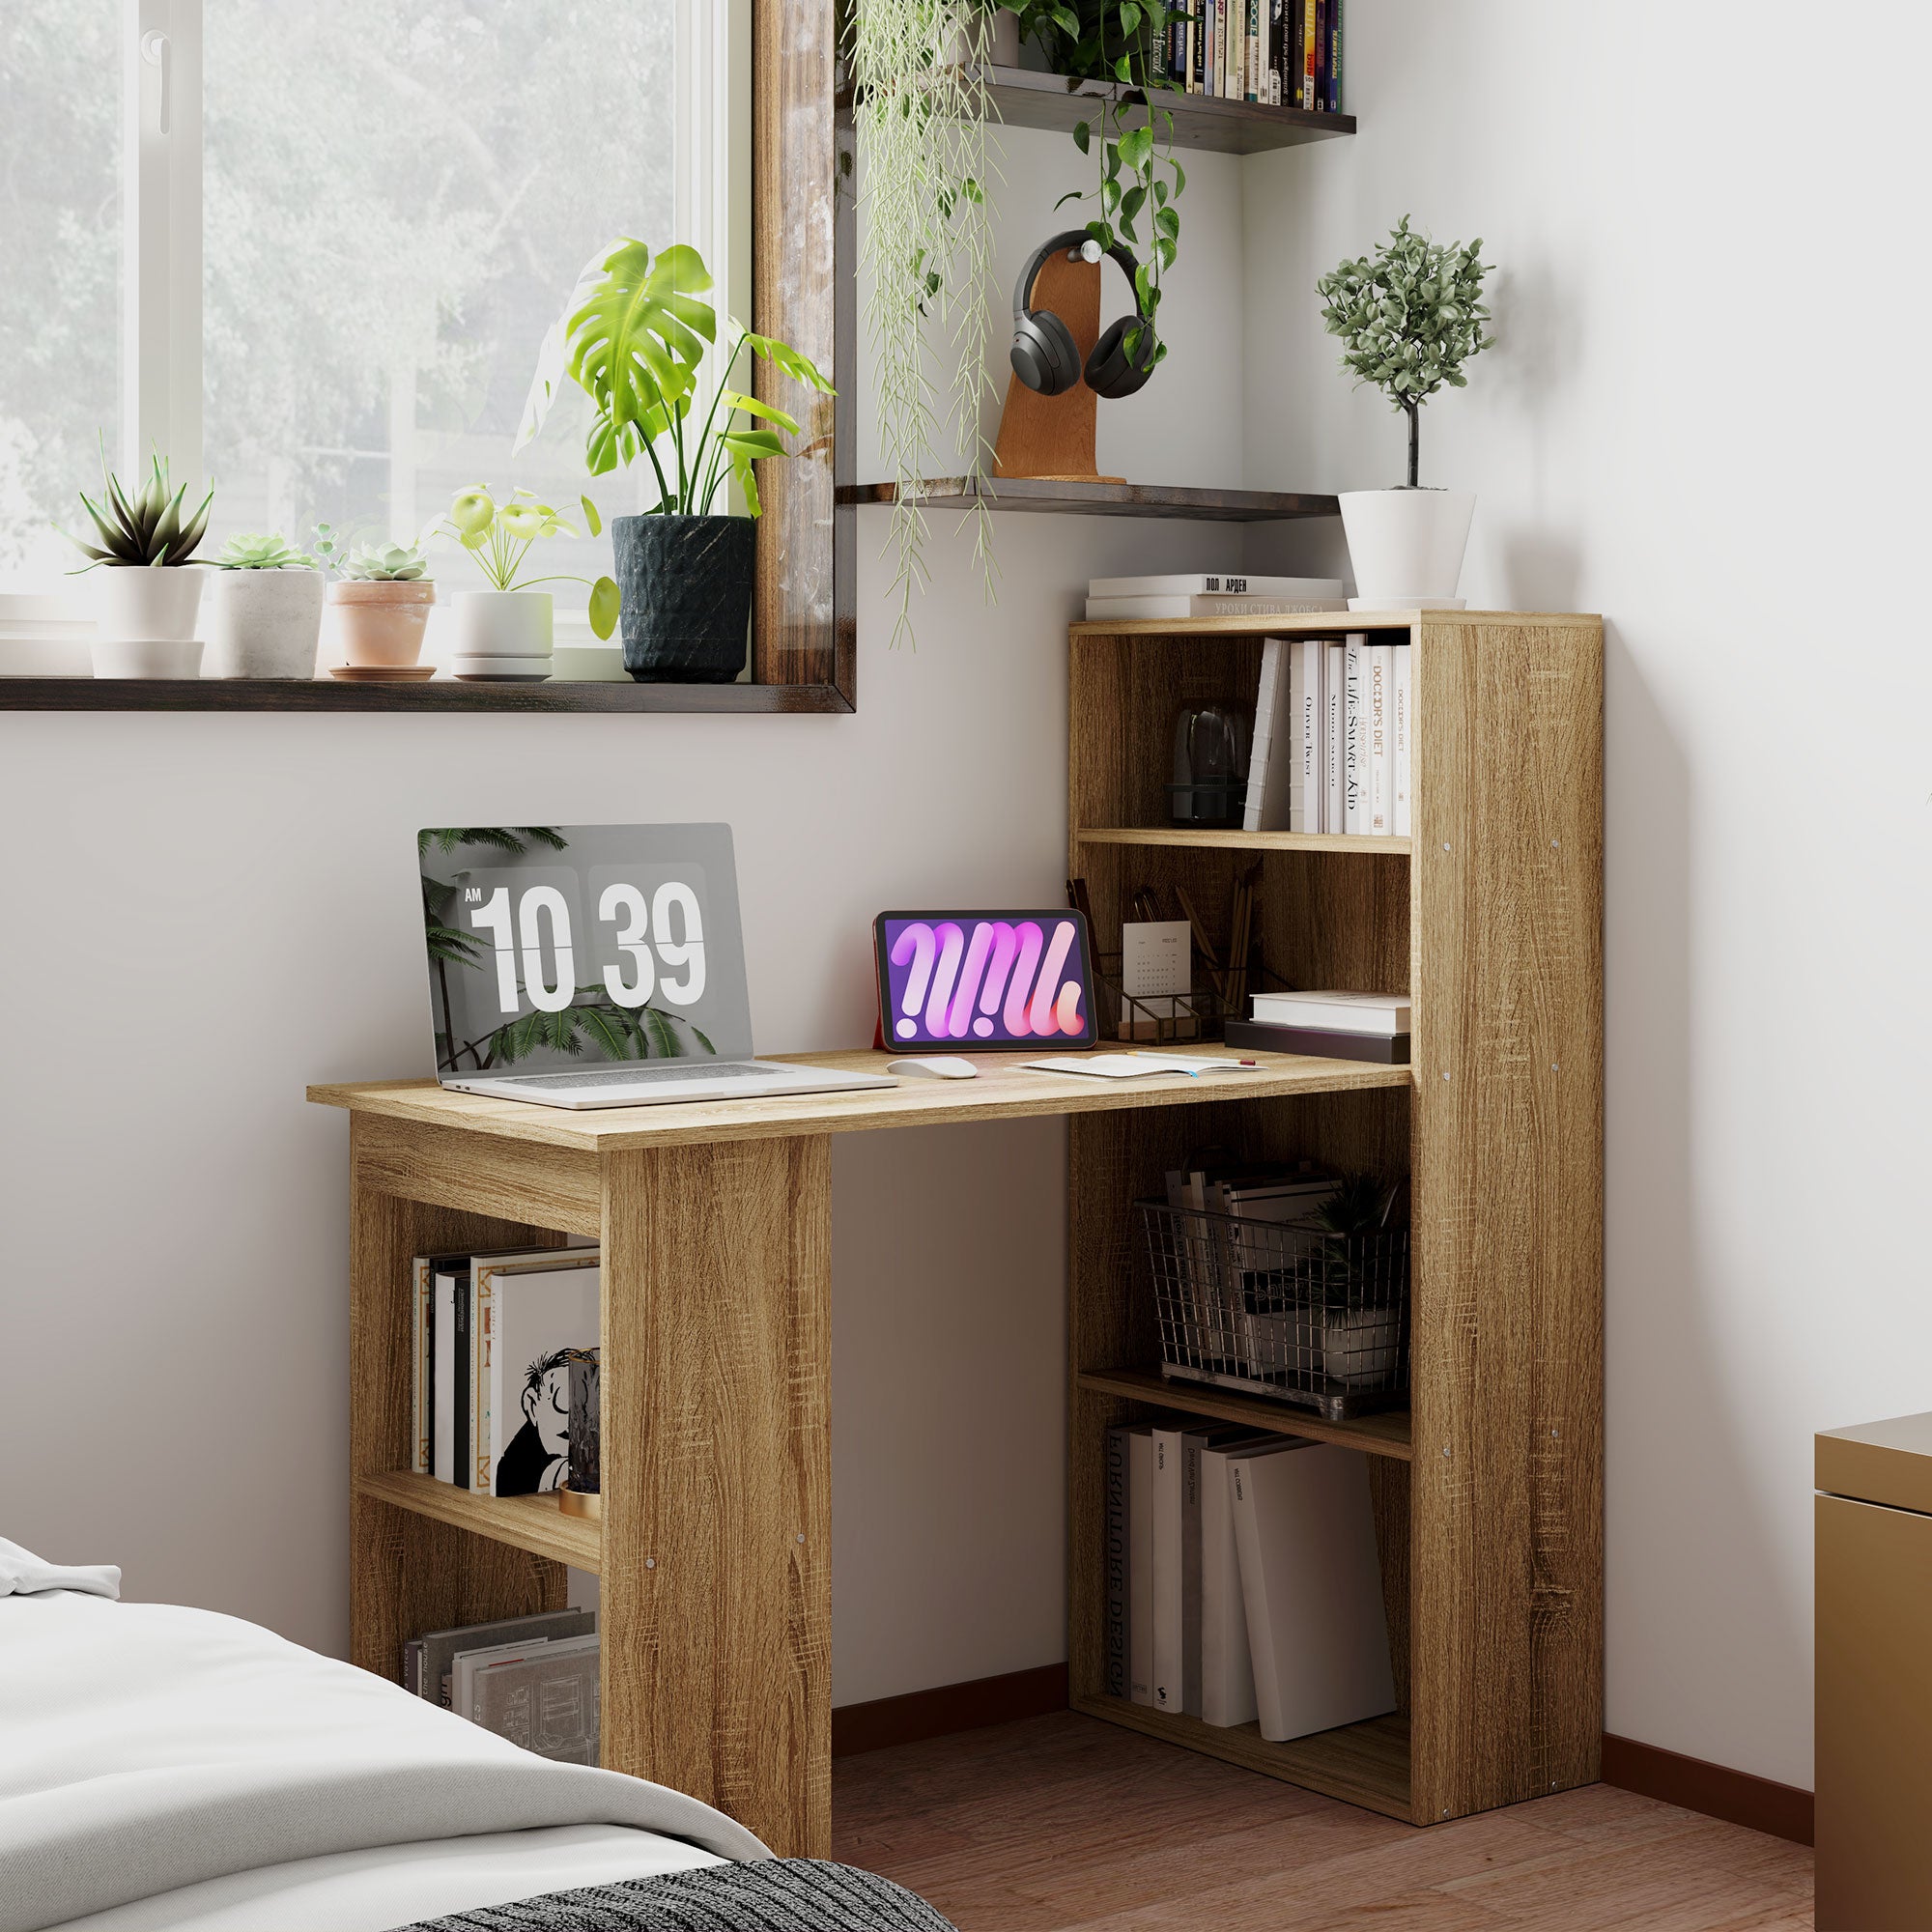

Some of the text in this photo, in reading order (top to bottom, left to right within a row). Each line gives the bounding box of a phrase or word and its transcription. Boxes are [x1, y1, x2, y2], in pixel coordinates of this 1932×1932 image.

[1206, 578, 1247, 594] ПОЛ АРДЕН
[1214, 602, 1247, 614] УРОКИ
[1249, 603, 1281, 614] СТИВА
[1373, 729, 1383, 757] DIET
[465, 888, 482, 902] AM
[470, 881, 707, 1012] 10 39
